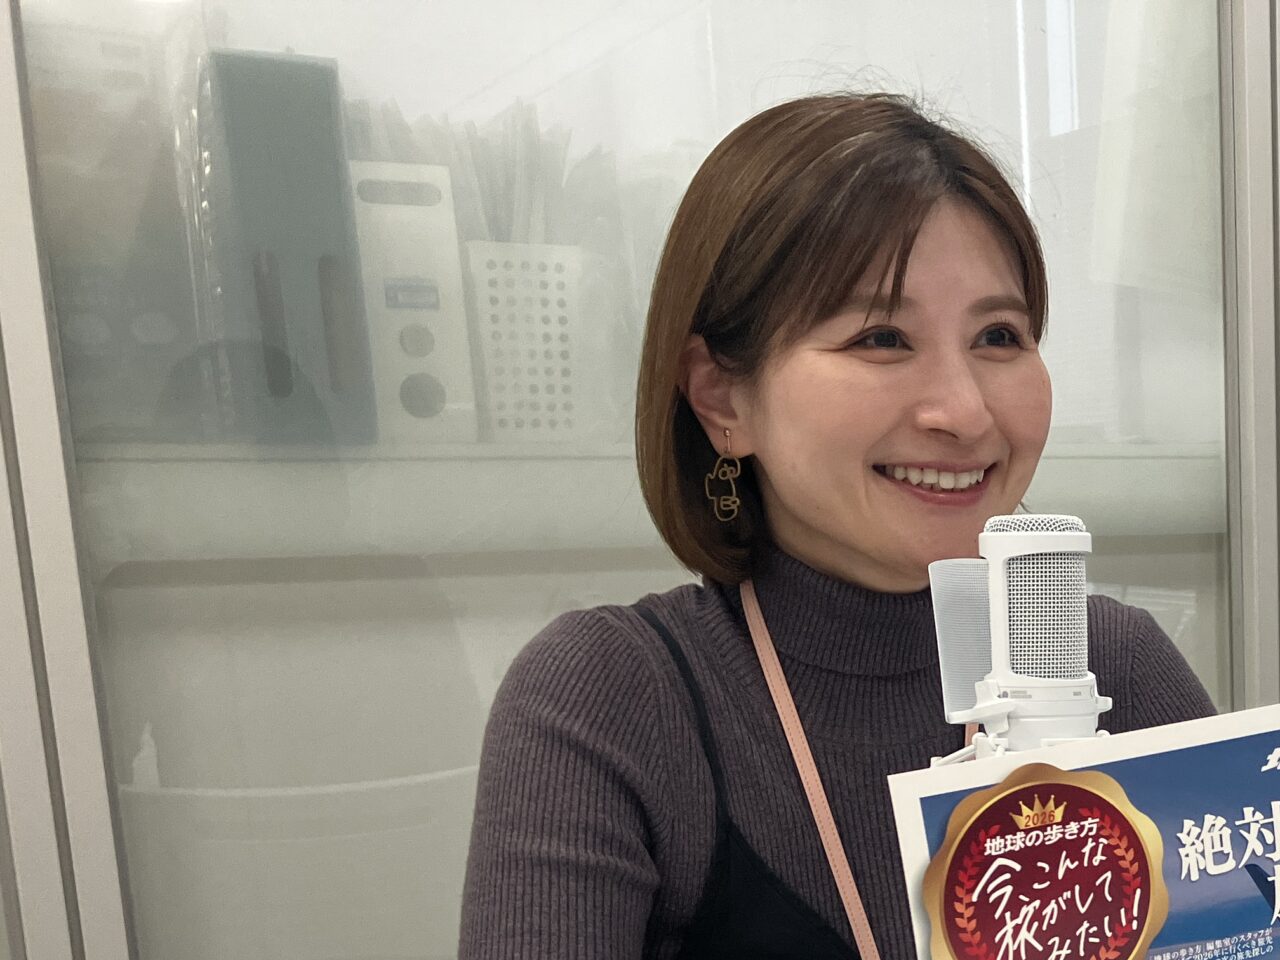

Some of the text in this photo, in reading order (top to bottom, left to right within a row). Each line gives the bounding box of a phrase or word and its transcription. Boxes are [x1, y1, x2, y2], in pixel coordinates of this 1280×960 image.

[1024, 810, 1056, 828] 2026
[984, 817, 1099, 857] 地球の歩き方
